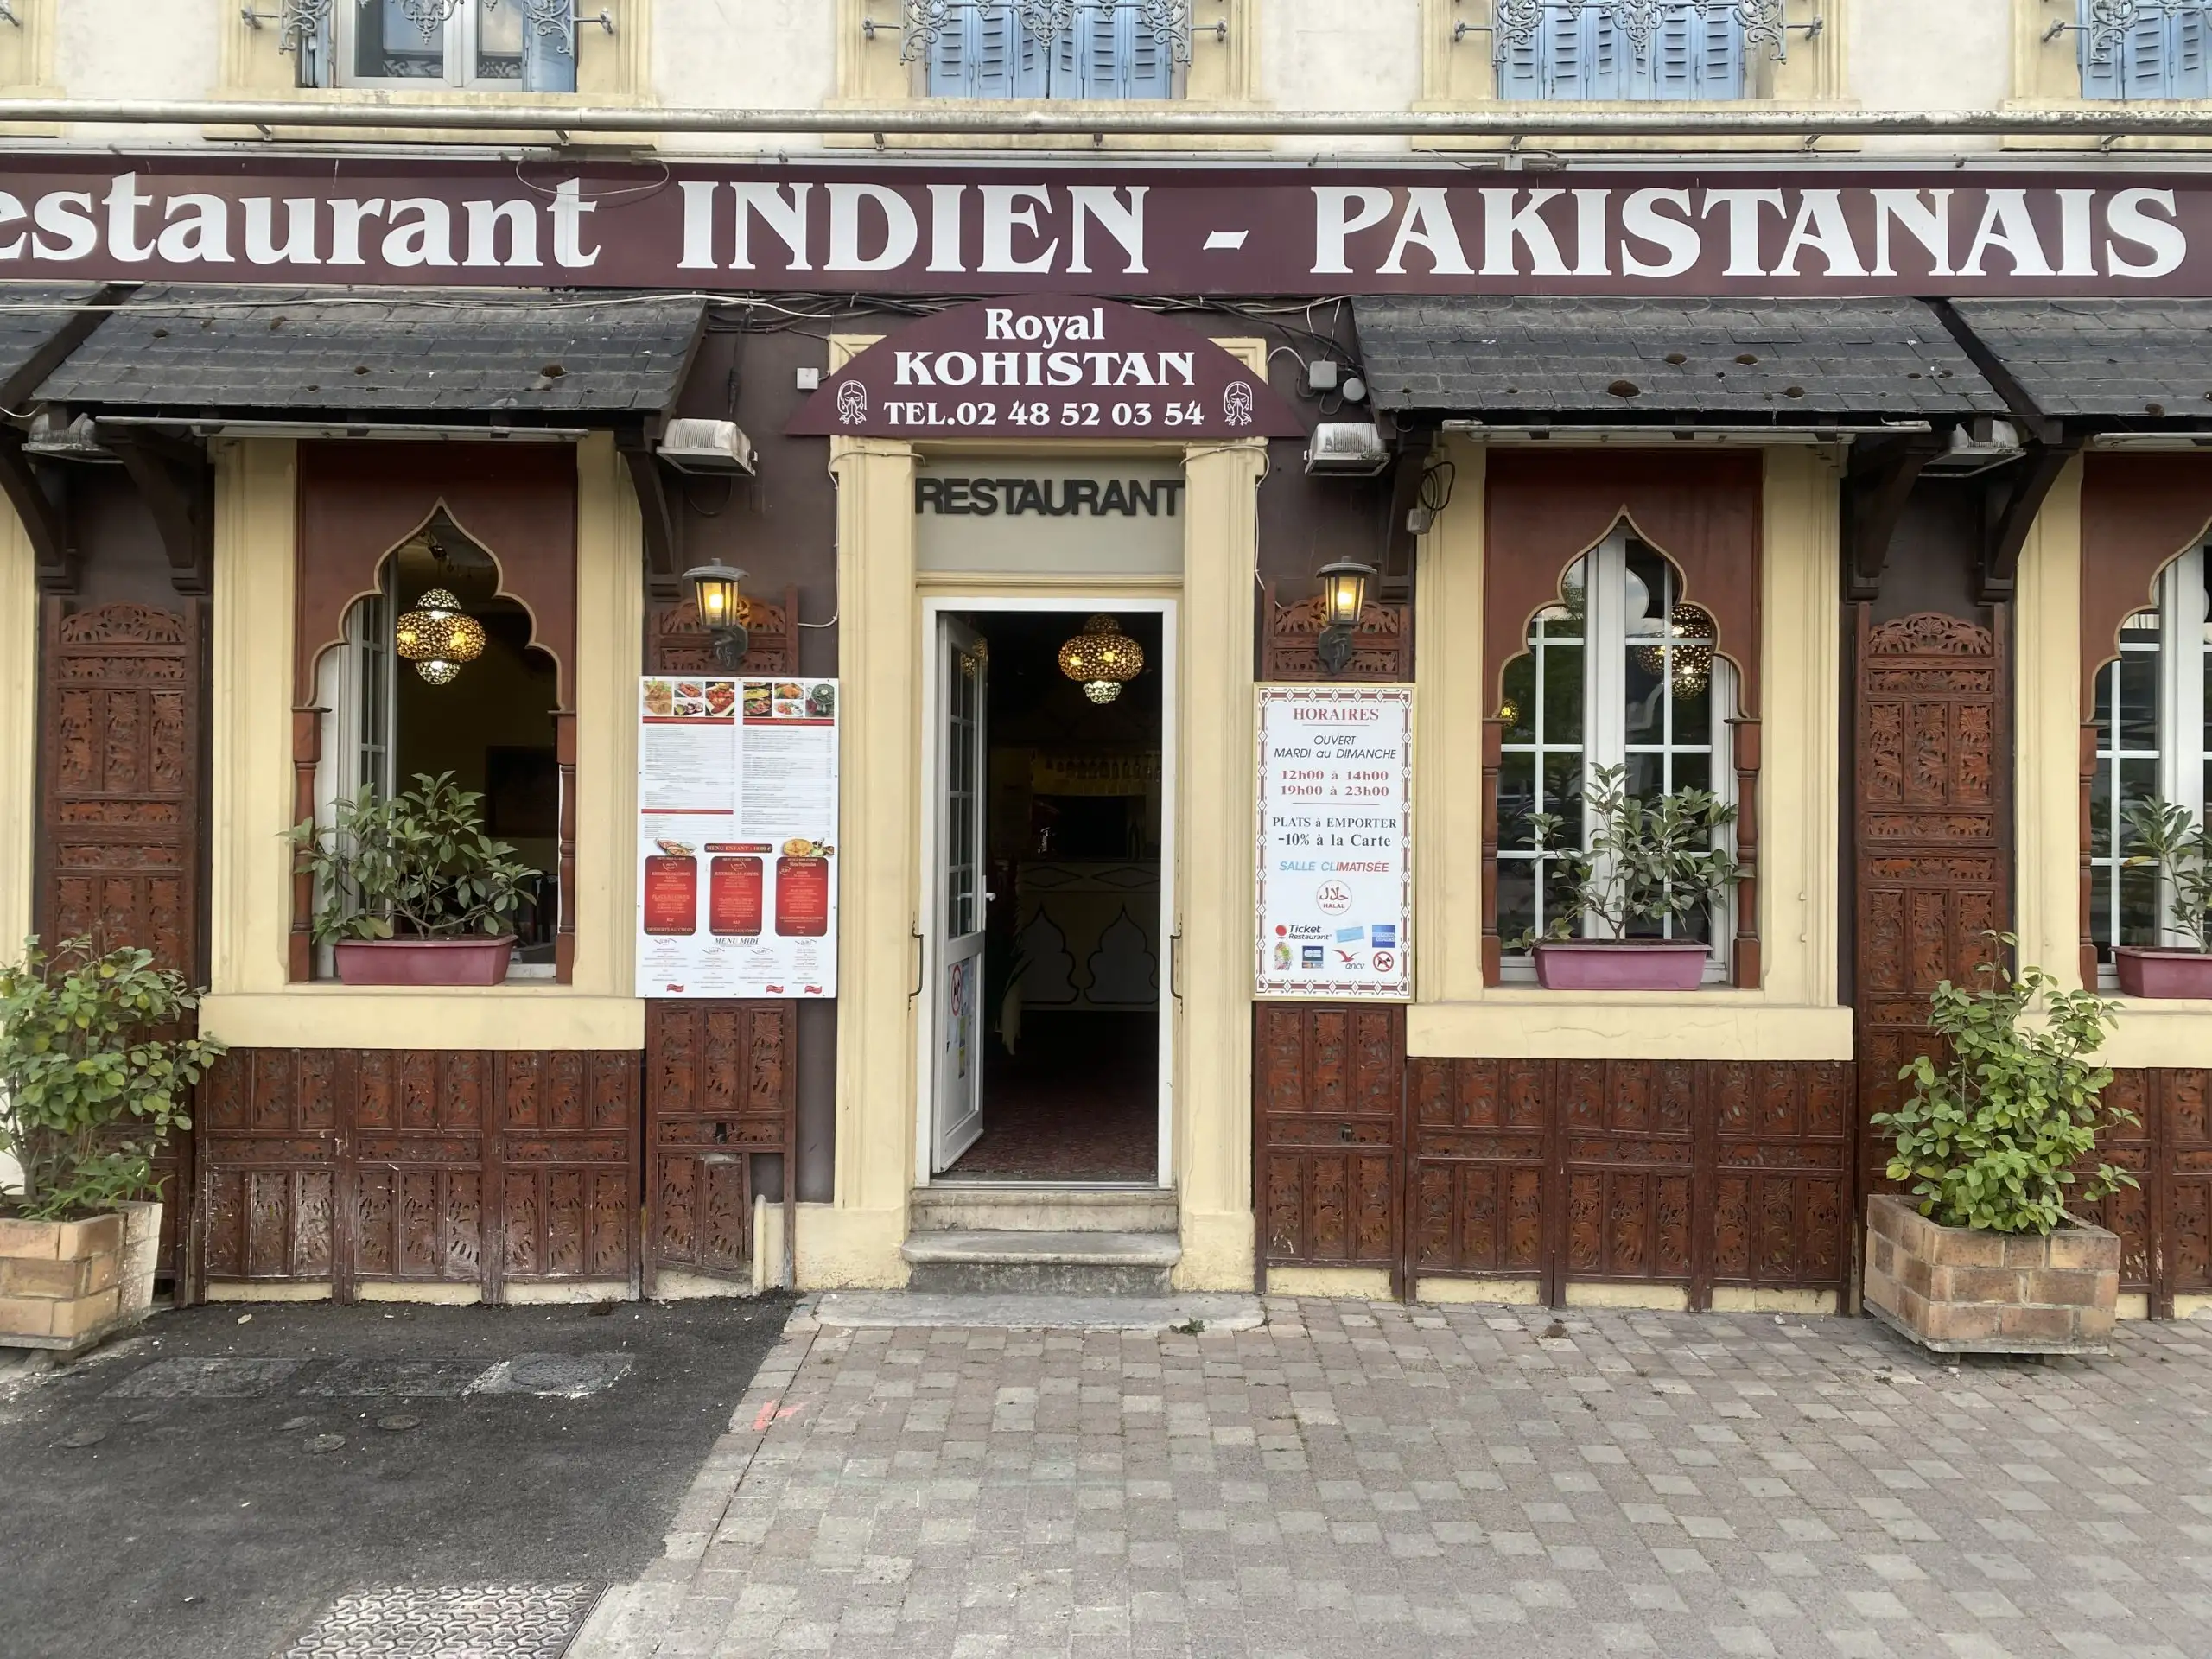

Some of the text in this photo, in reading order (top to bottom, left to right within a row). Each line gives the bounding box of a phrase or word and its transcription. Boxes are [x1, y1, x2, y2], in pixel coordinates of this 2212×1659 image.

[677, 181, 1150, 274] INDIEN
[1203, 230, 1249, 251] -
[1308, 186, 2187, 278] PAKISTANAIS
[985, 308, 1104, 349] Royal
[893, 350, 1195, 387] KOHISTAN
[1008, 400, 1051, 426] 48
[1060, 402, 1100, 426] 52
[1111, 402, 1153, 426] 03
[1163, 400, 1205, 426] 54
[916, 478, 1185, 517] RESTAURANT
[1294, 708, 1379, 721] HORAIRES
[1313, 735, 1357, 745] OUVERT
[1274, 748, 1396, 759] MARDI au DIMANCHE
[1281, 770, 1389, 781] 12h00 à 14h00
[1281, 785, 1389, 796] 19h00 à 23h00
[1273, 817, 1397, 829] PLATS à EMPORTER
[1278, 833, 1391, 847] -10% à la Carte
[1279, 860, 1389, 872] SALLE CLIMATISÉE
[1288, 924, 1321, 933] Ticket
